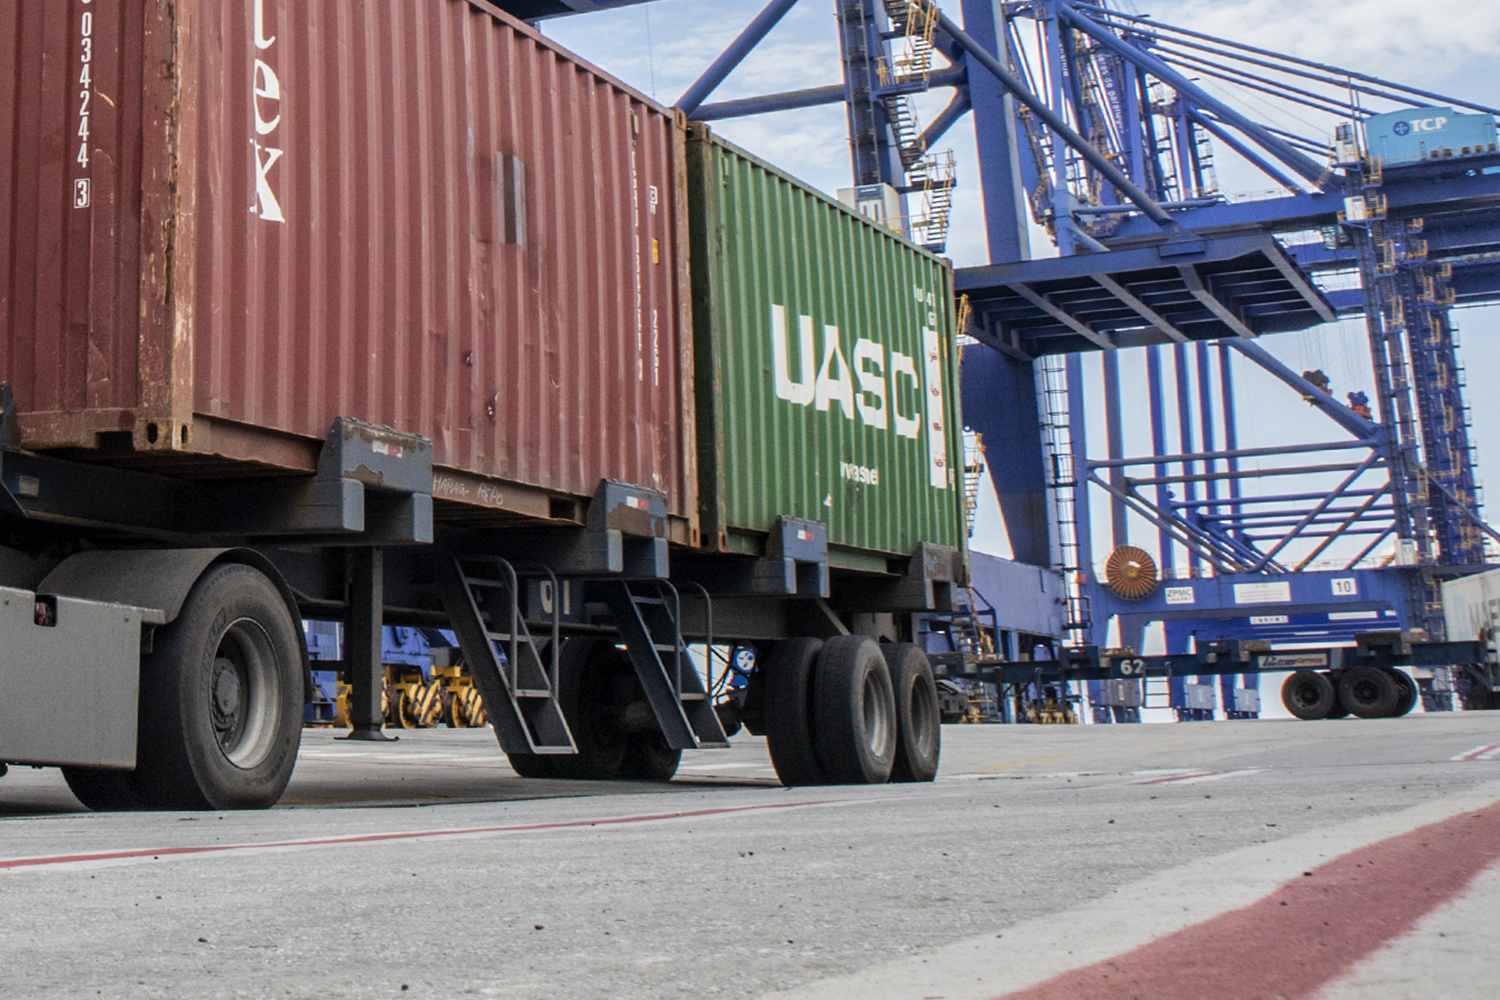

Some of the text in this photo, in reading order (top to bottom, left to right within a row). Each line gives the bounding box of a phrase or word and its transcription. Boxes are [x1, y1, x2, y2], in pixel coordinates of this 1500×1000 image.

[76, 12, 92, 169] 034244
[1409, 116, 1449, 132] TCP
[75, 179, 90, 208] 3
[771, 303, 922, 440] UASC
[1334, 580, 1352, 593] 10
[1120, 659, 1144, 675] 62
